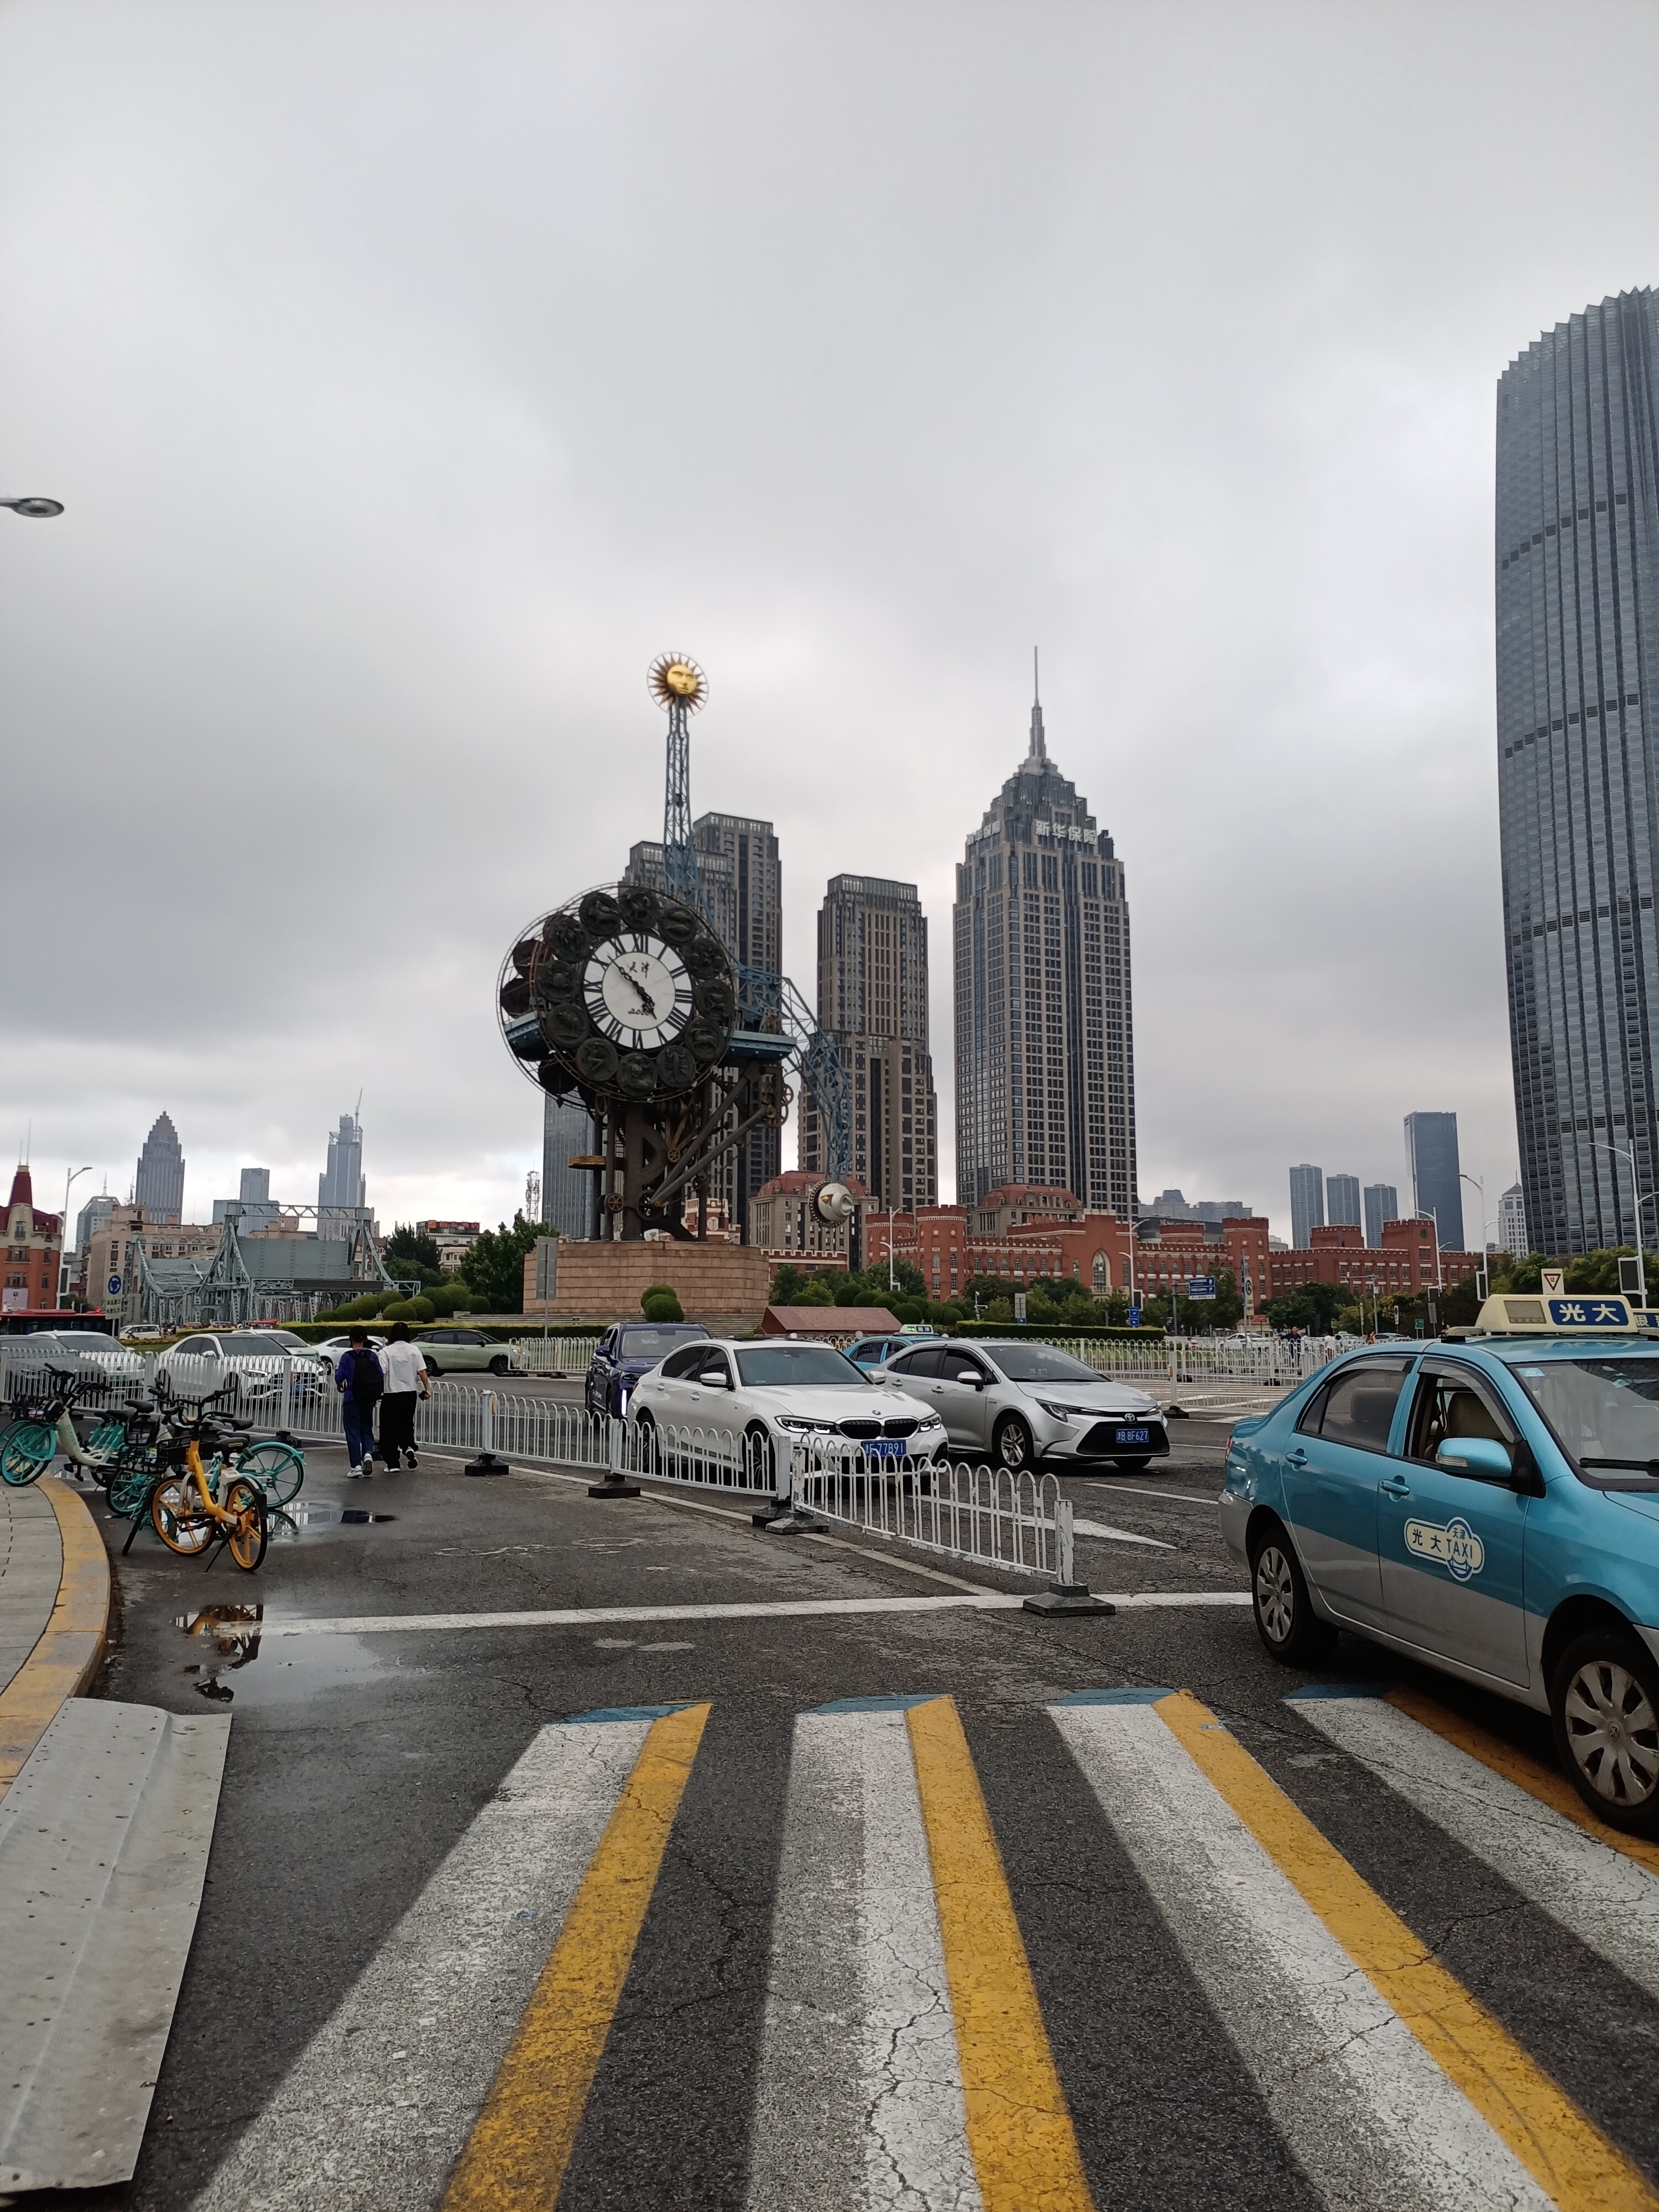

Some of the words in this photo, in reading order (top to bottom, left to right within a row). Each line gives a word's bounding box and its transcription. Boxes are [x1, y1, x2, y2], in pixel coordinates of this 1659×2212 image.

[967, 821, 1001, 846] 新华保险
[1035, 820, 1098, 846] 新华保险
[676, 989, 692, 1004] III
[1559, 1303, 1620, 1322] 光大
[1412, 1528, 1442, 1553] 光大
[1453, 1527, 1465, 1540] 天津
[1446, 1538, 1473, 1559] TAXI
